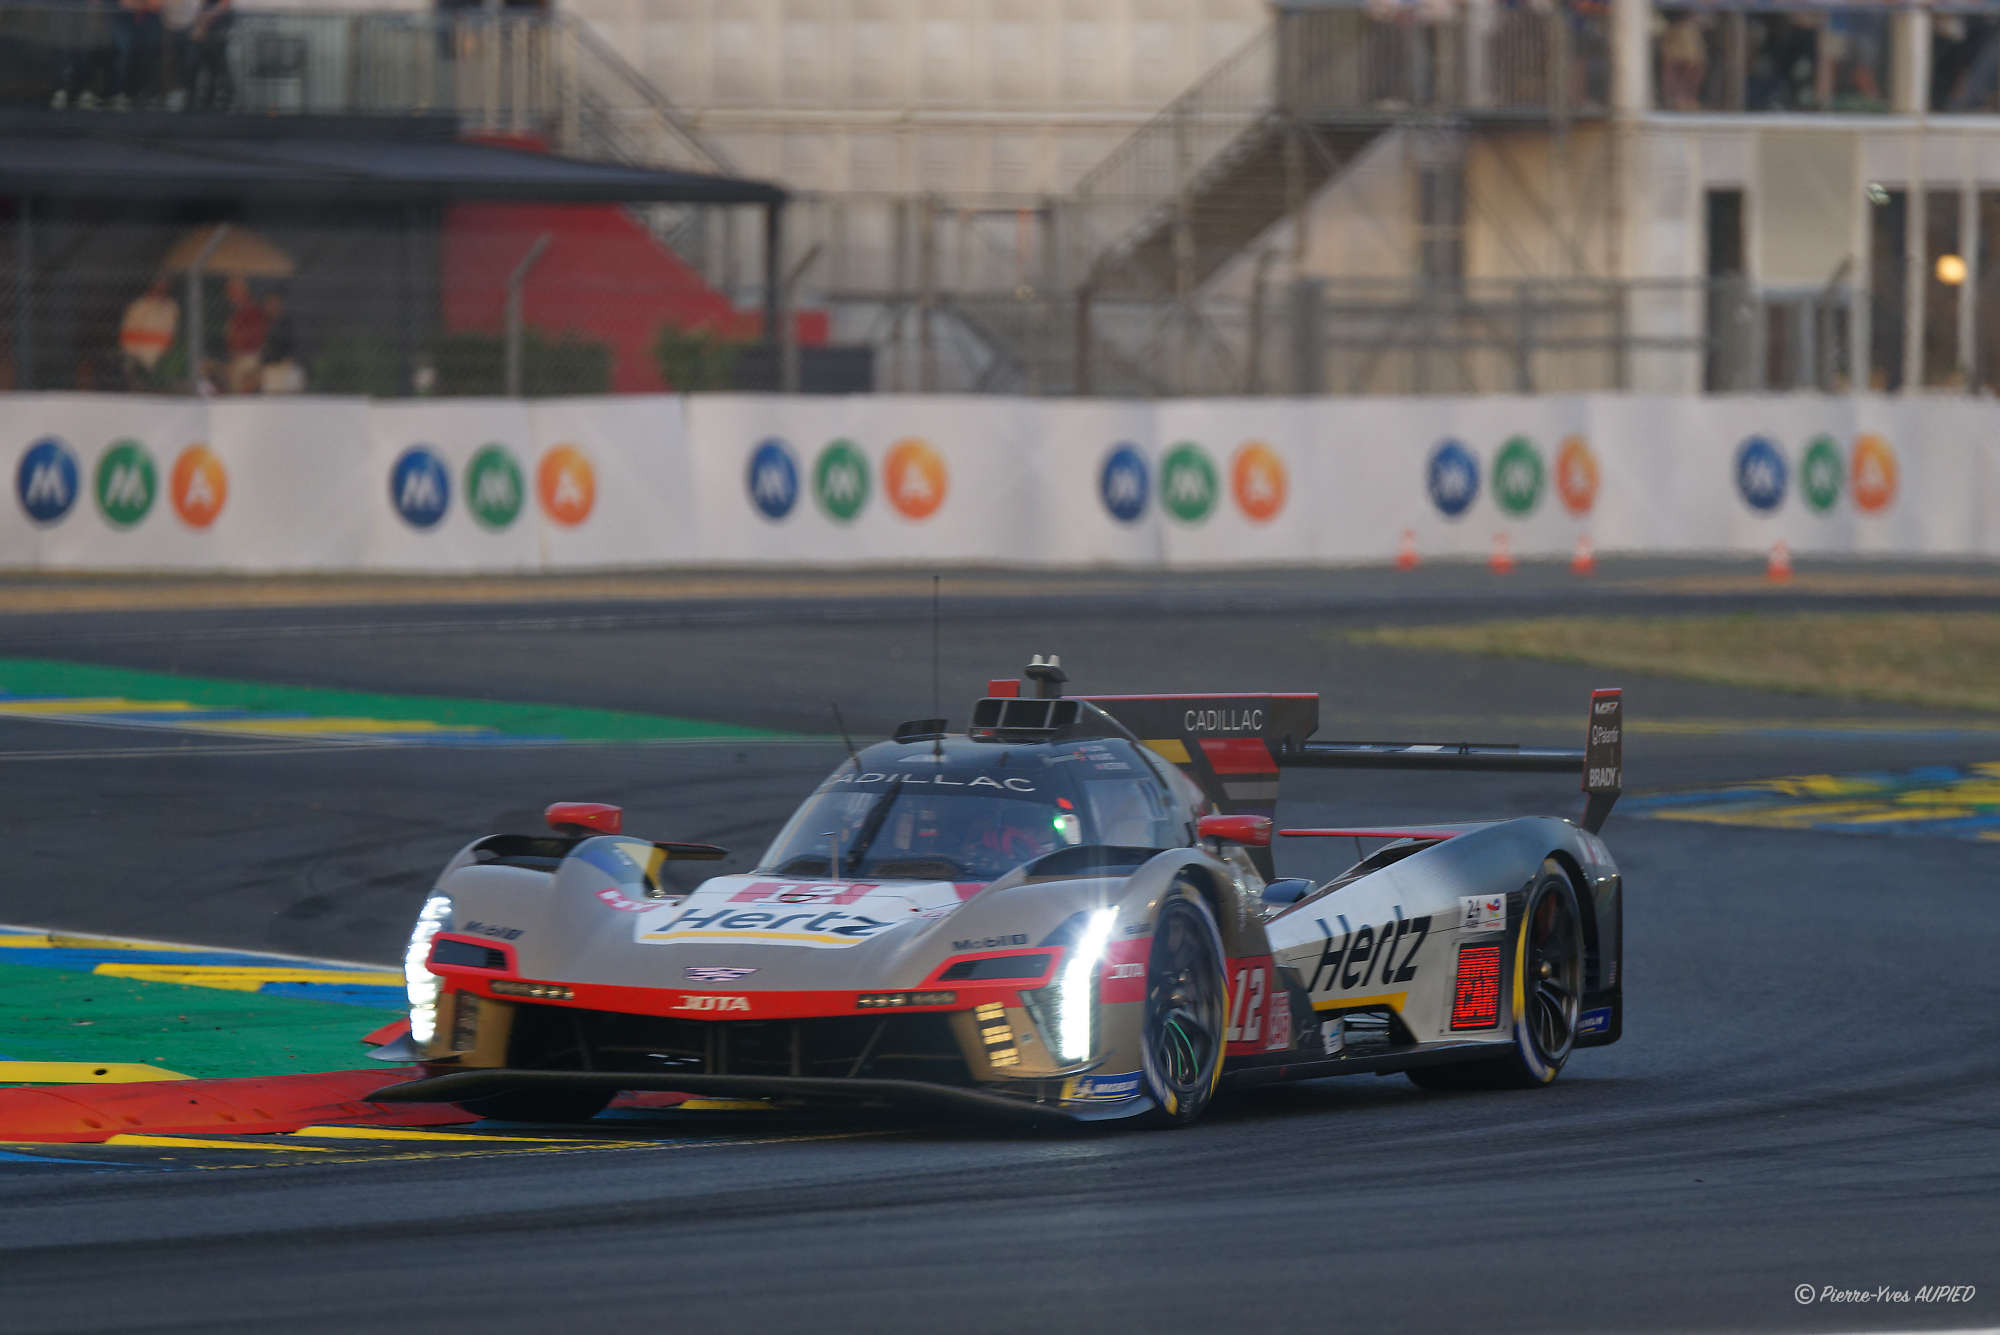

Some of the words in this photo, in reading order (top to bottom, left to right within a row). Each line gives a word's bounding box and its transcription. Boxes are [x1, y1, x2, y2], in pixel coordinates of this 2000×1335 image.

[1184, 709, 1263, 731] CADILLAC
[830, 772, 1036, 792] ADILLAC
[1589, 767, 1617, 787] BRADY
[655, 908, 897, 936] Hertz
[1308, 904, 1433, 993] Hertz
[671, 995, 752, 1011] JOTA
[1226, 968, 1265, 1041] 12
